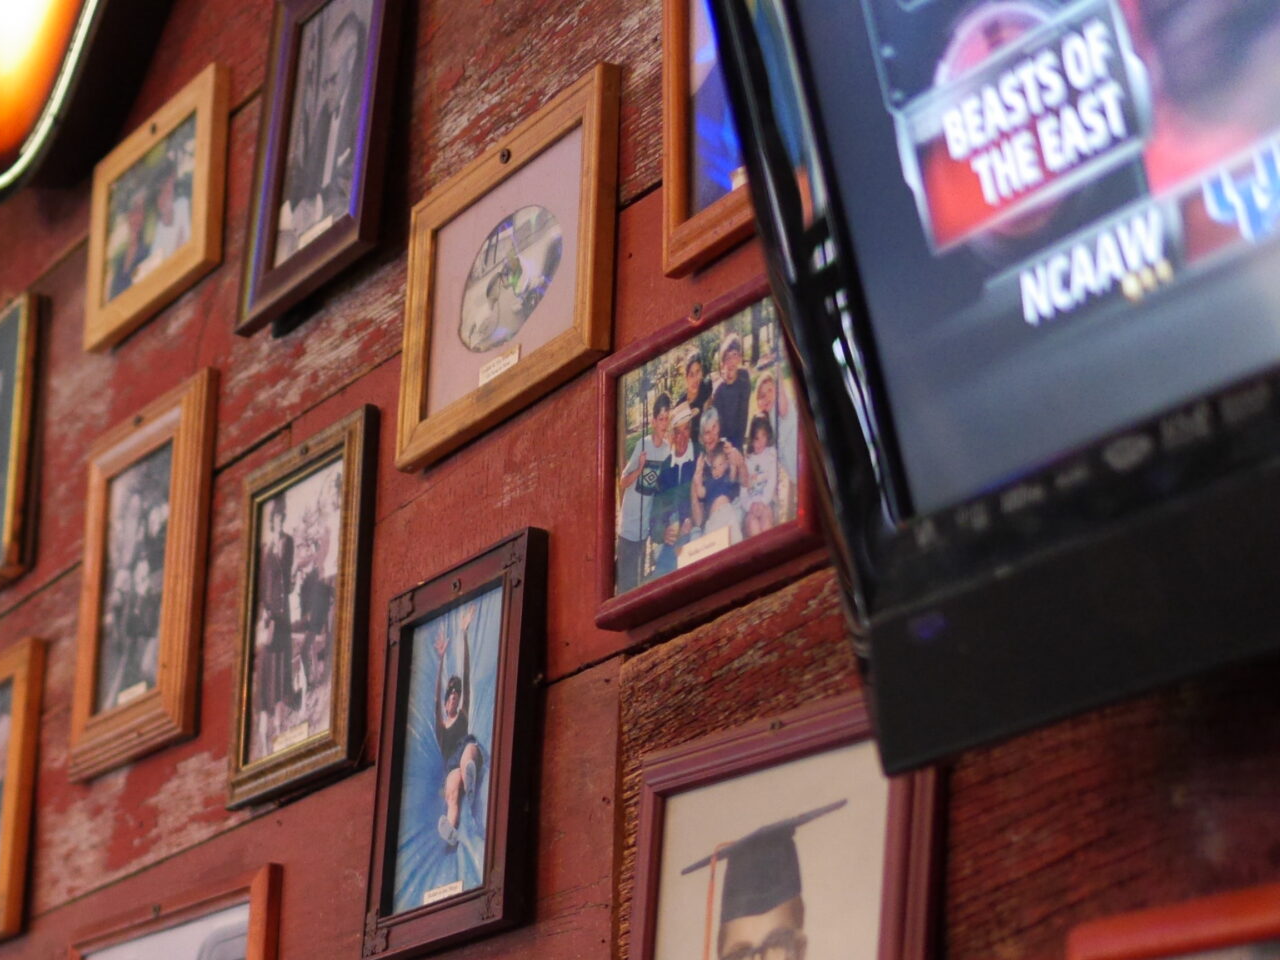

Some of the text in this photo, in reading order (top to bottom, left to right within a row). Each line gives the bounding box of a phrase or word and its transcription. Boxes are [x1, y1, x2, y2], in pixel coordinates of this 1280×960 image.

[941, 18, 1113, 161] BEASTS OF
[970, 78, 1127, 206] THE EAST
[1020, 205, 1163, 326] NCAAW
